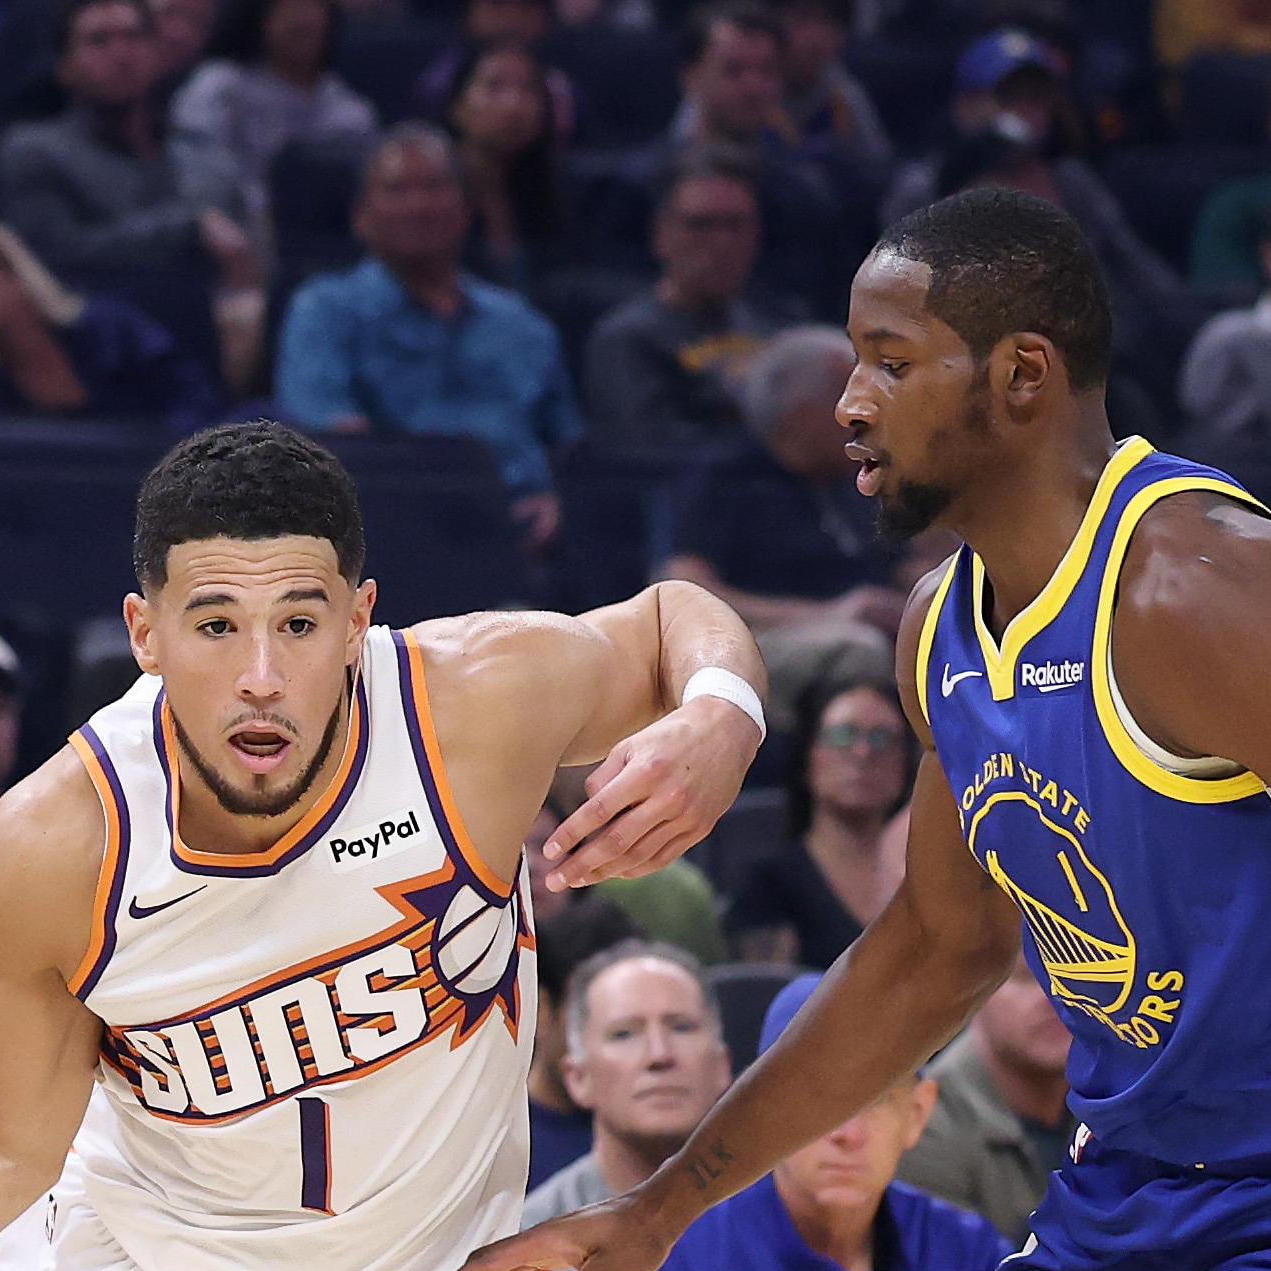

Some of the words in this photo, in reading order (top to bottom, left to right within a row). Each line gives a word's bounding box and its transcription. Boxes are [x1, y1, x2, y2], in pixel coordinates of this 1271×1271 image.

[329, 810, 421, 863] PayPal
[958, 752, 1015, 830] OLDEN
[123, 944, 428, 1116] SUNS
[295, 1097, 337, 1217] 1
